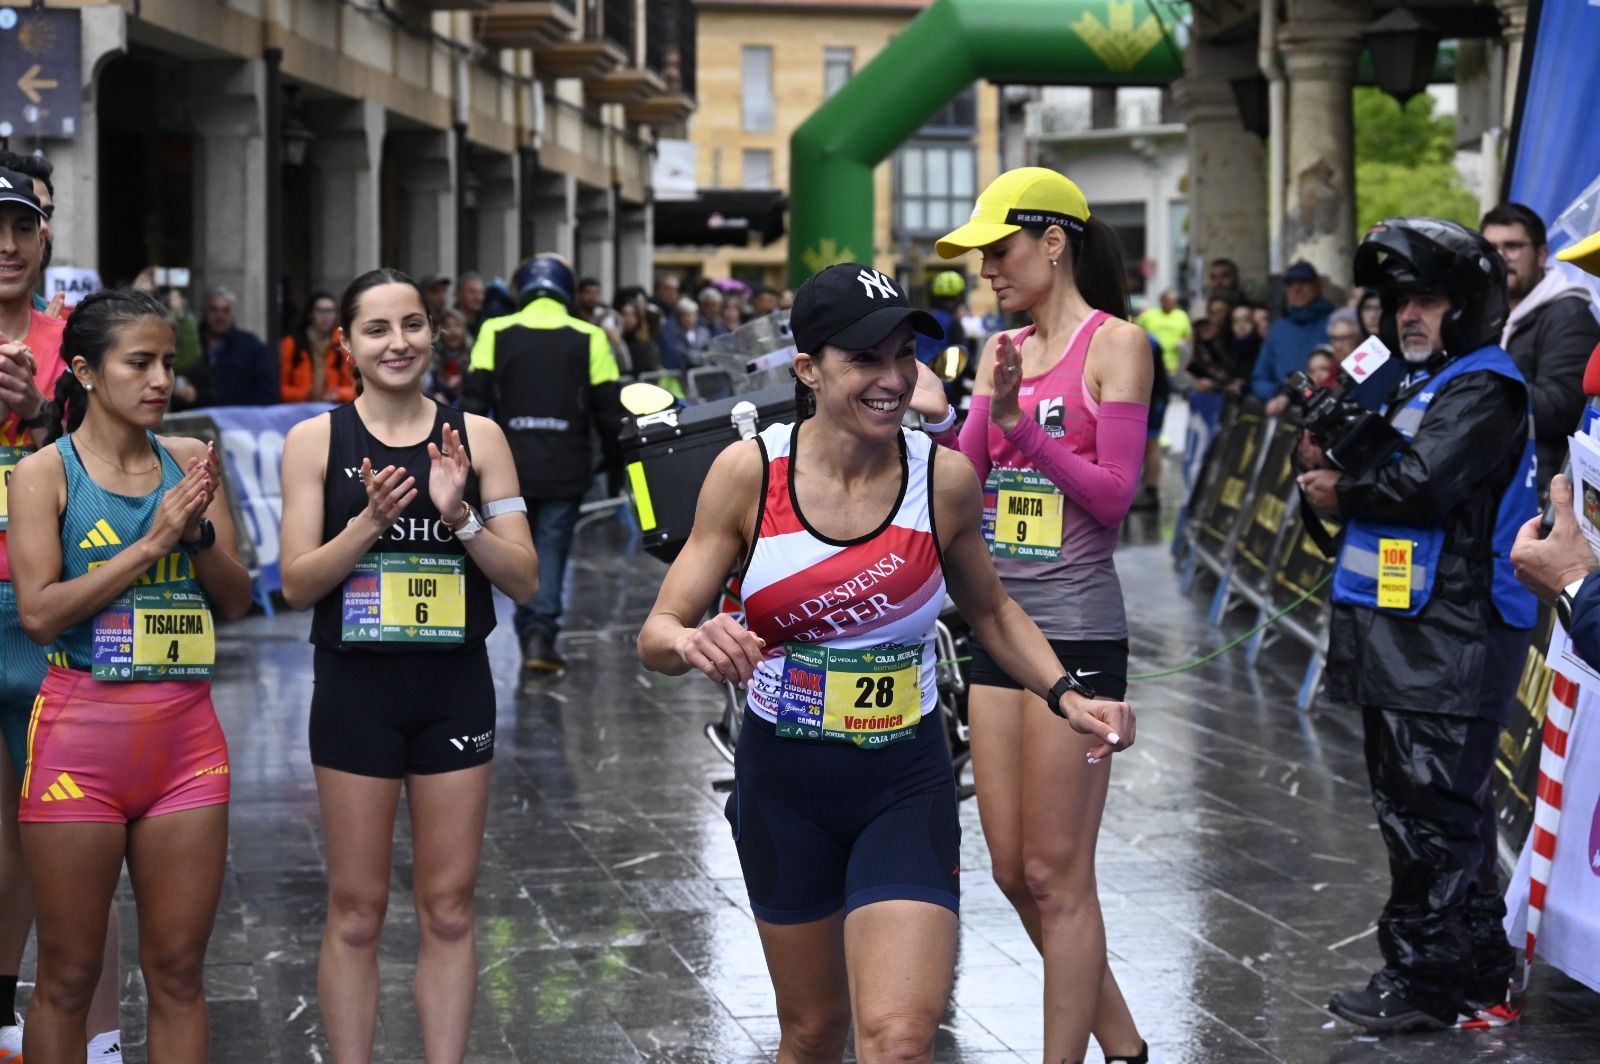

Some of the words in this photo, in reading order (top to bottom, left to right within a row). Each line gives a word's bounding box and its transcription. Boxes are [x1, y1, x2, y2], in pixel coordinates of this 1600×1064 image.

[857, 269, 898, 299] NY
[1008, 496, 1043, 517] MARTA
[1016, 520, 1027, 542] 9
[420, 558, 436, 566] CAJA
[1383, 548, 1408, 565] 10K
[408, 578, 437, 597] LUCI
[774, 612, 802, 628] LA
[800, 552, 905, 618] DESPENSA
[367, 606, 378, 615] 26
[415, 602, 428, 624] 6
[794, 627, 825, 641] DE
[821, 593, 903, 635] FER
[144, 614, 204, 635] TISALEMA
[438, 629, 463, 637] RURAL
[119, 644, 131, 653] 26
[166, 639, 179, 663] 4
[875, 655, 896, 663] CAJA
[896, 649, 919, 662] RURAL
[168, 667, 185, 675] CAJA
[186, 667, 210, 675] RURAL
[788, 668, 823, 692] 10K
[783, 691, 824, 706] ASTORGA
[784, 683, 812, 695] CIUDAD
[812, 690, 823, 698] DE
[854, 676, 895, 708] 28
[808, 705, 821, 716] 26
[816, 720, 821, 728] A
[844, 714, 904, 730] Verónica
[868, 735, 889, 744] CAJA
[890, 728, 913, 741] RURAL
